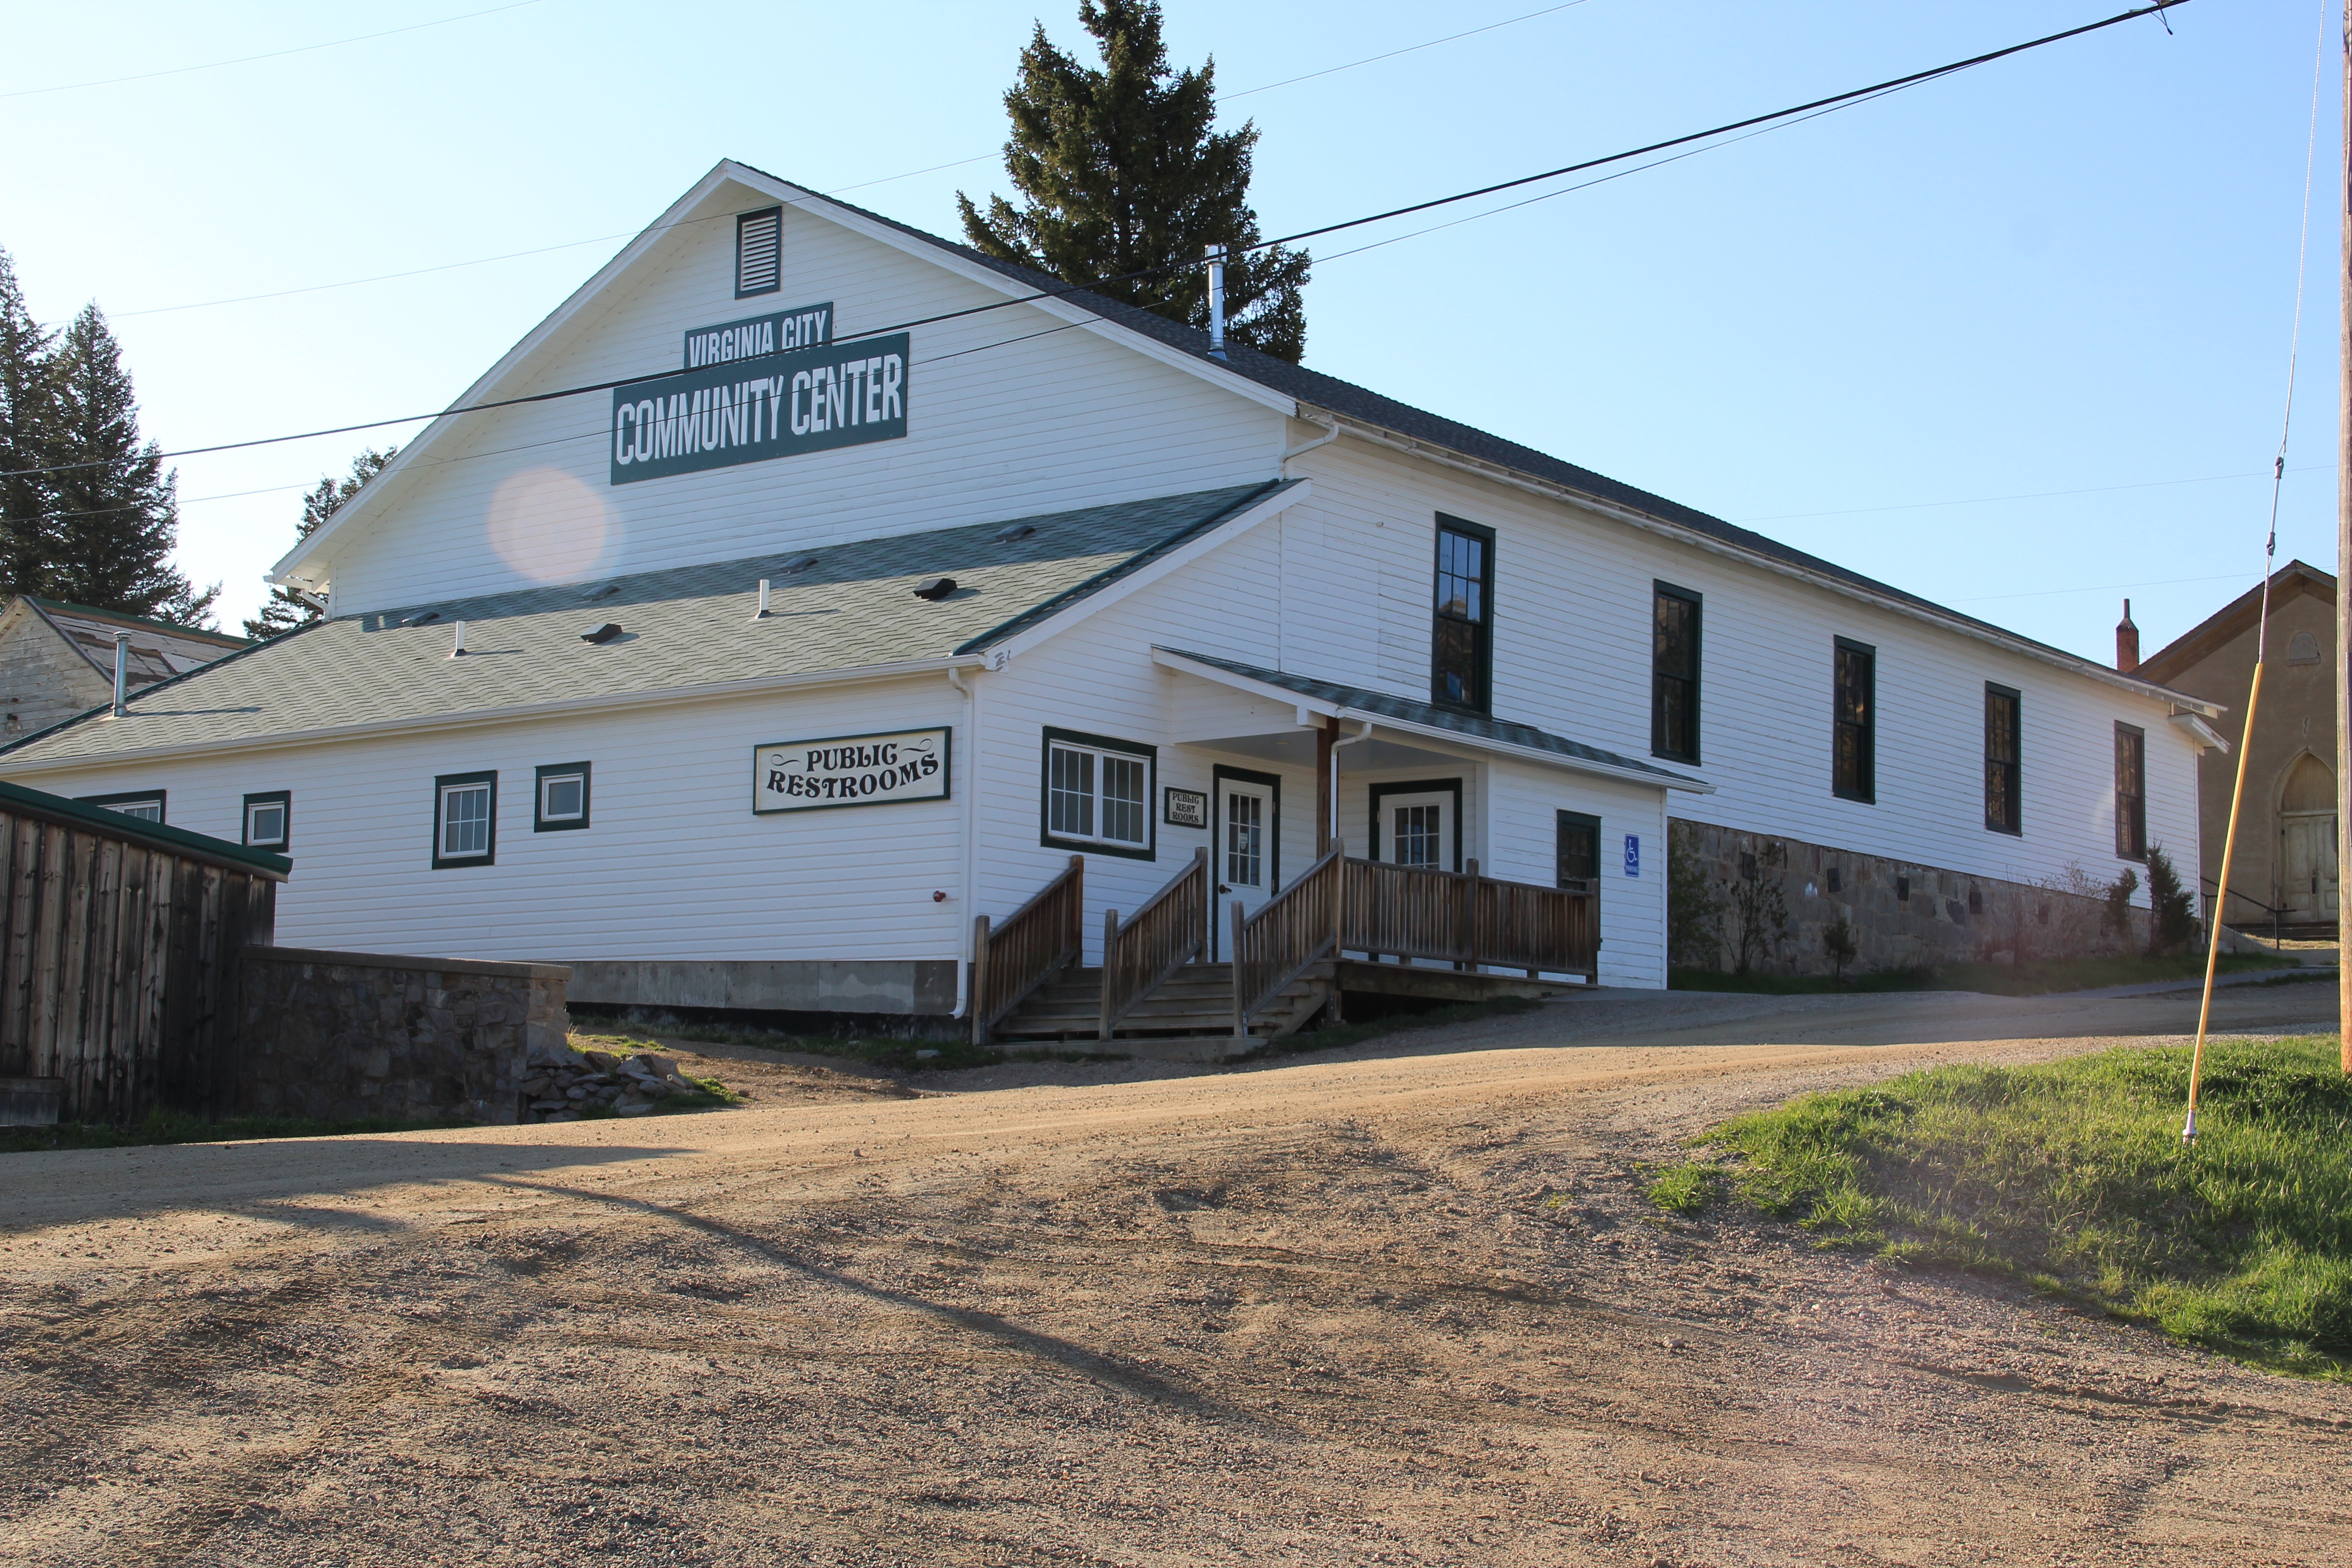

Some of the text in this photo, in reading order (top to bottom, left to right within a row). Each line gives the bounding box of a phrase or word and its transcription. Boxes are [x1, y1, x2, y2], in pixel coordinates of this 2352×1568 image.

[689, 310, 827, 368] VIRGINIA CITY
[617, 354, 902, 465] COMMUNITY CENTER
[806, 743, 898, 772] PUBLIC
[767, 752, 939, 799] RESTROOMS
[1172, 792, 1199, 804] PUBLIC
[1176, 803, 1195, 813] REST
[1172, 812, 1199, 823] ROOMS
